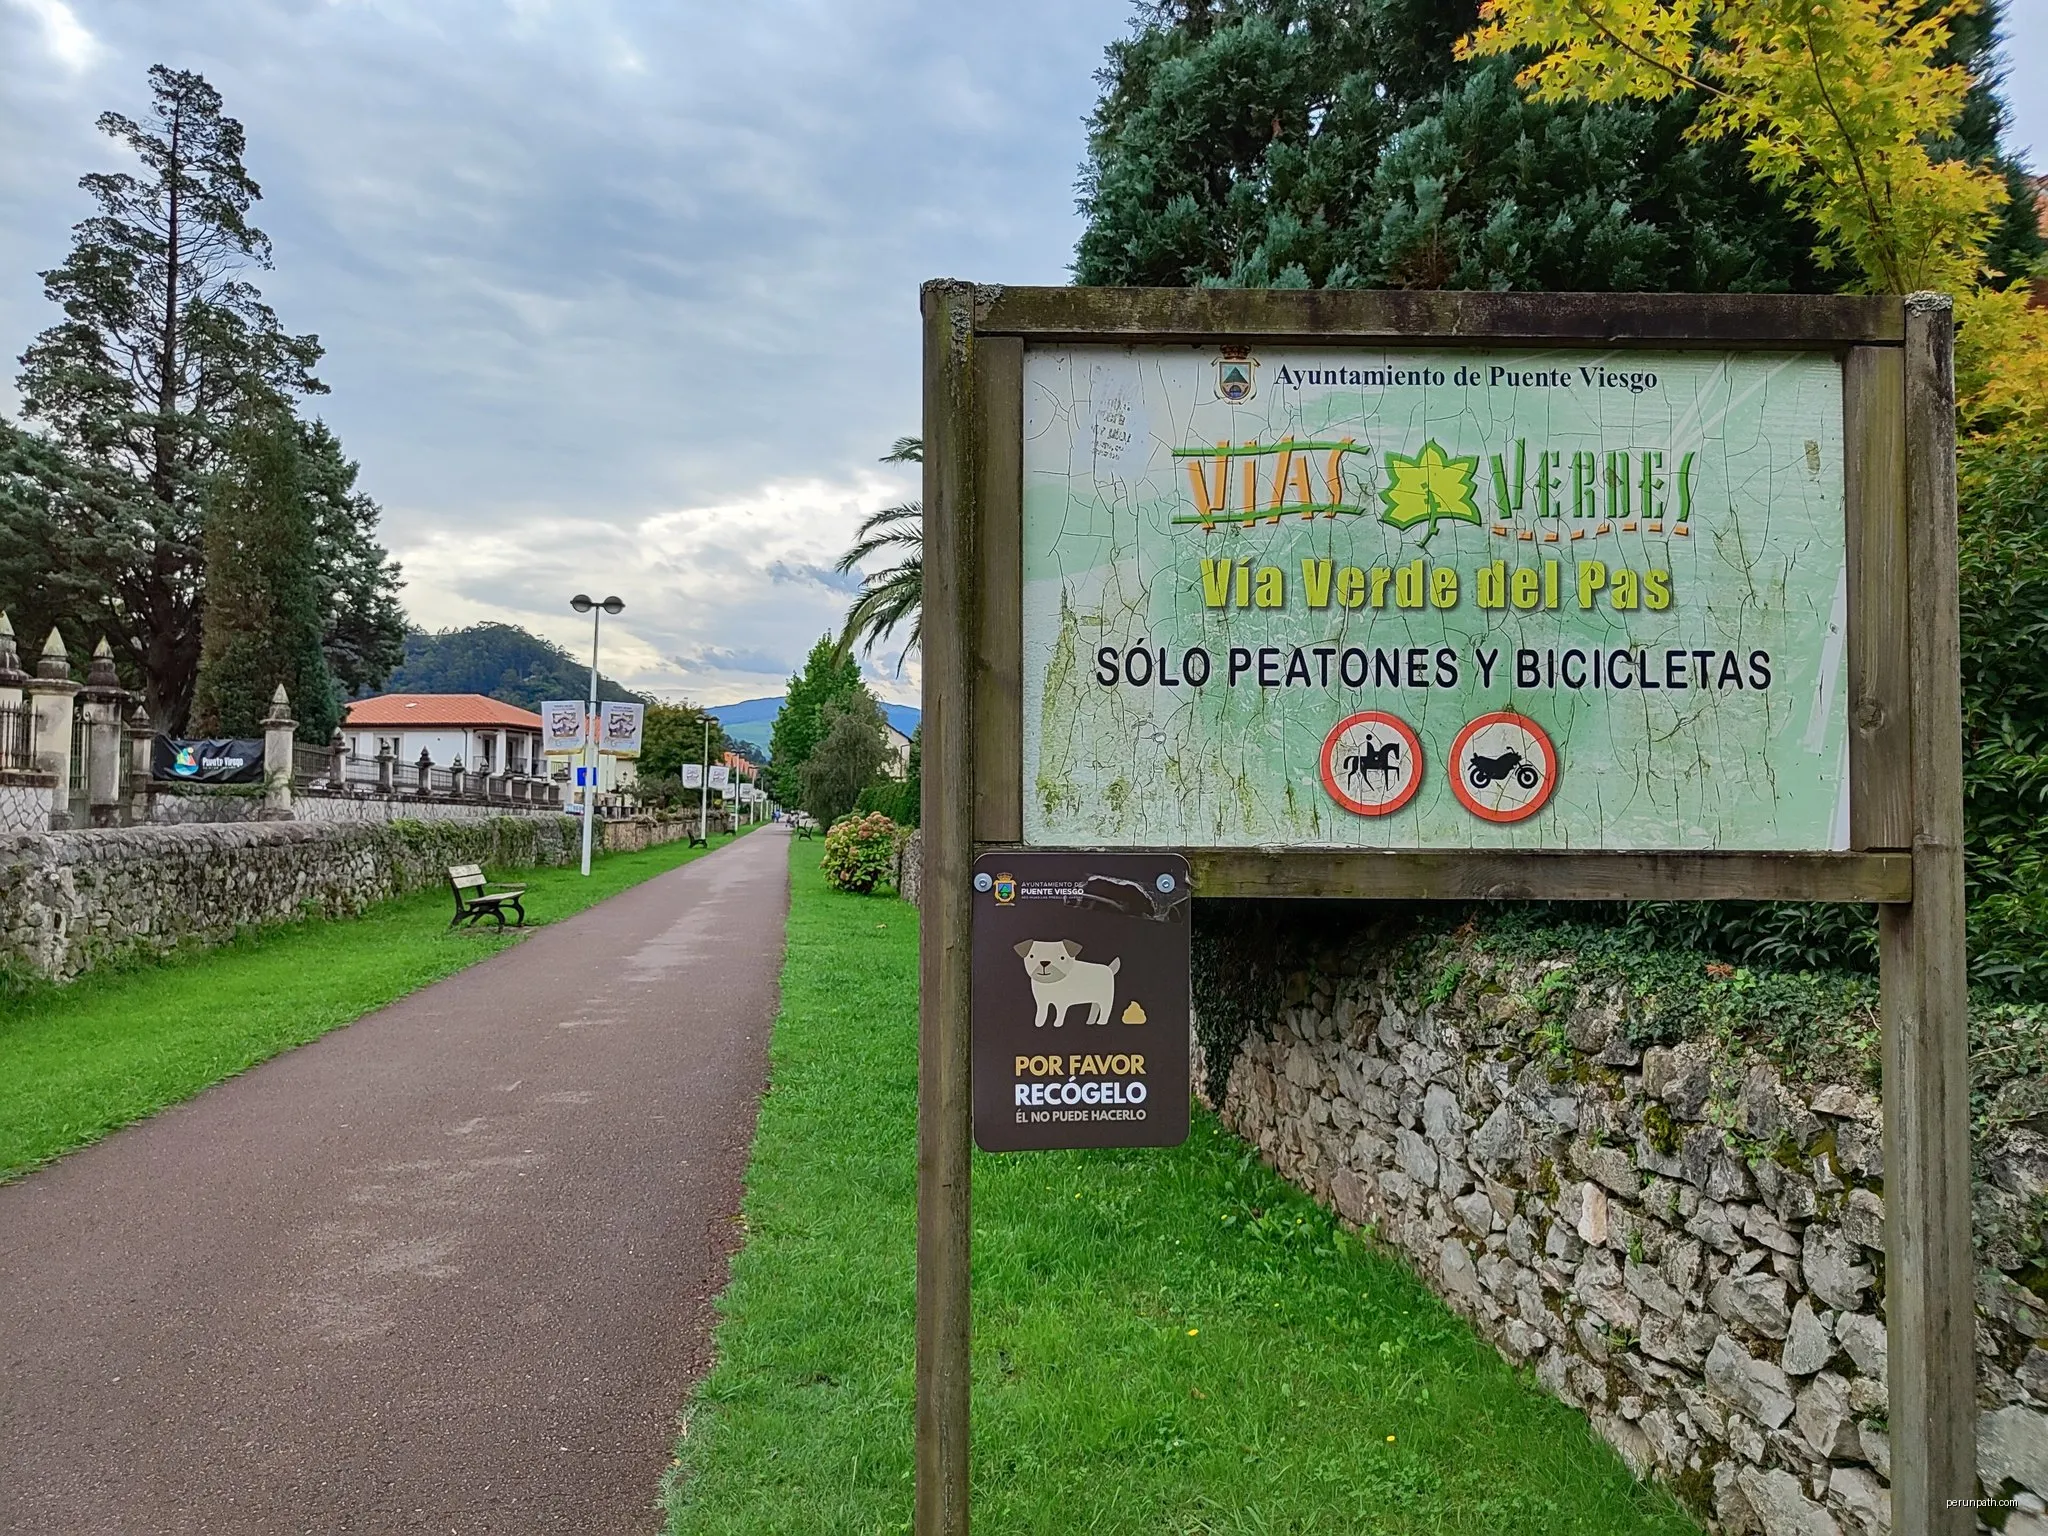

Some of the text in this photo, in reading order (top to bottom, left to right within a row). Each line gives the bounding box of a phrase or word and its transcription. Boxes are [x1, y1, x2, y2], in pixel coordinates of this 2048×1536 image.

[1273, 364, 1658, 393] Ayuntamiento de Puente Viesgo
[1490, 436, 1696, 523] VERDES
[1200, 556, 1672, 610] Vía Verde del Pas
[1096, 637, 1772, 690] SÓLO PEATONES Y BICICLETAS
[1015, 1054, 1147, 1077] POR FAVOR
[1015, 1075, 1147, 1106] RECÓGELO
[1015, 1108, 1147, 1123] ÉL NO PUEDE HACERLO
